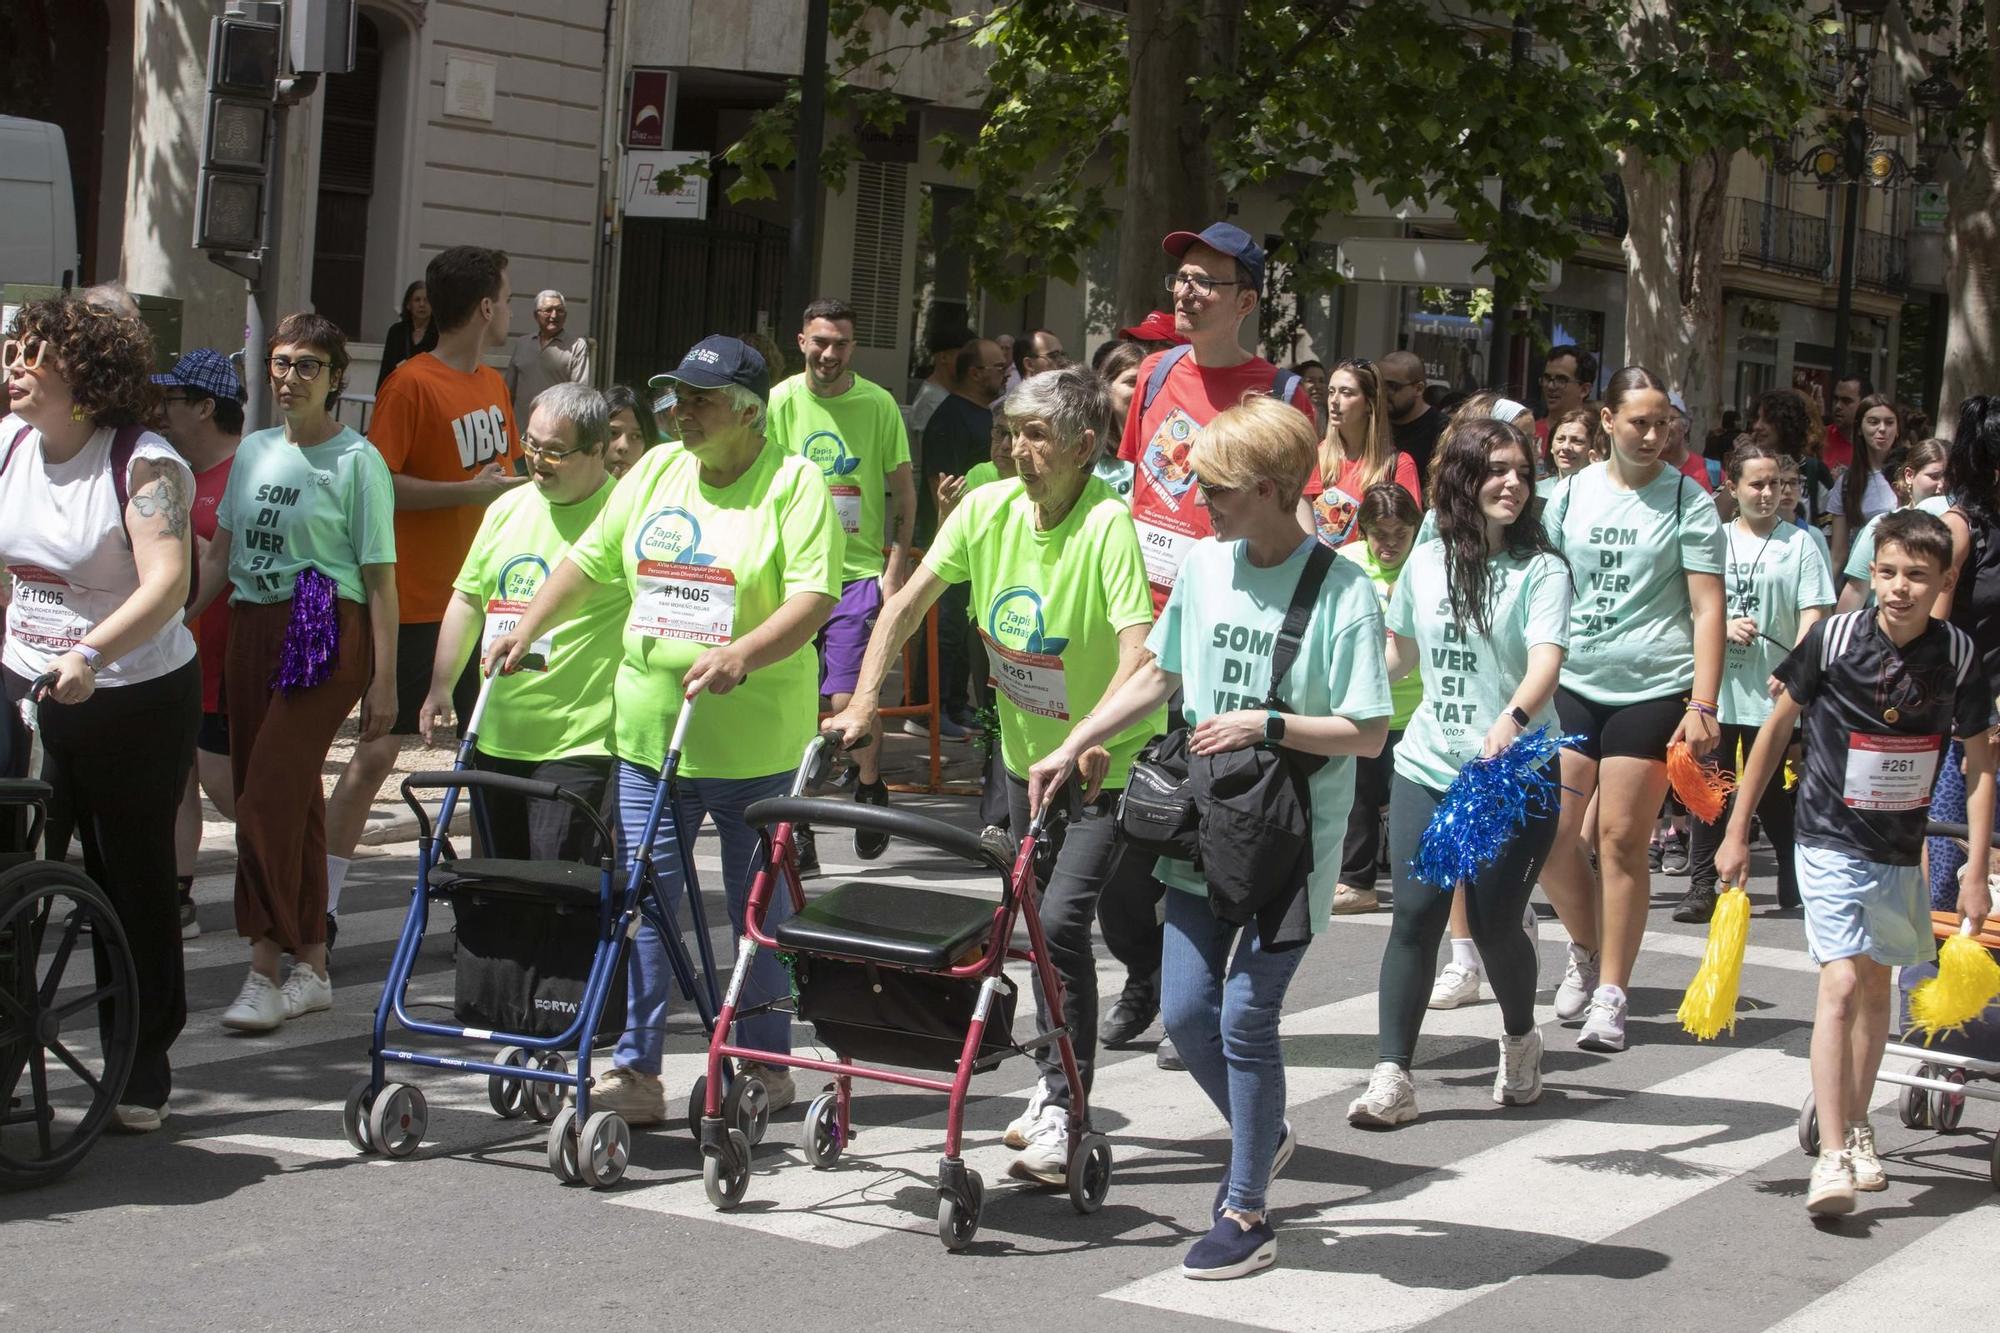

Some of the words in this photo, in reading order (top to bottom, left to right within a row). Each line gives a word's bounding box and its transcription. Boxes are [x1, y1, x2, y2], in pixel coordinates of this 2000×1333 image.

[451, 404, 508, 469] VBC
[812, 447, 833, 456] Tapis
[255, 484, 301, 507] SOM
[256, 508, 280, 528] DI
[245, 529, 284, 554] VER
[653, 527, 682, 541] Tapis
[1147, 532, 1172, 549] #261
[1589, 527, 1638, 545] SOM
[645, 537, 682, 553] Canals
[250, 555, 275, 571] SI
[1600, 550, 1623, 569] DI
[1727, 562, 1766, 575] SOM
[253, 572, 280, 592] AT
[513, 574, 536, 586] Tais
[1590, 573, 1631, 593] VER
[22, 588, 64, 605] #1005
[509, 584, 534, 597] Caals
[664, 585, 710, 602] #1005
[1595, 596, 1616, 613] SI
[498, 620, 515, 632] #10
[1006, 610, 1030, 626] Tapis
[662, 628, 720, 643] DIVERSITAT
[1213, 623, 1274, 657] SOM
[1443, 622, 1467, 645] DI
[1431, 648, 1478, 673] VER
[1002, 662, 1033, 682] #261
[1222, 658, 1252, 687] DI
[1441, 676, 1465, 698] SI
[1213, 689, 1262, 714] VER
[1433, 701, 1477, 725] TAT
[1881, 759, 1915, 773] #261
[1854, 800, 1877, 808] SOM
